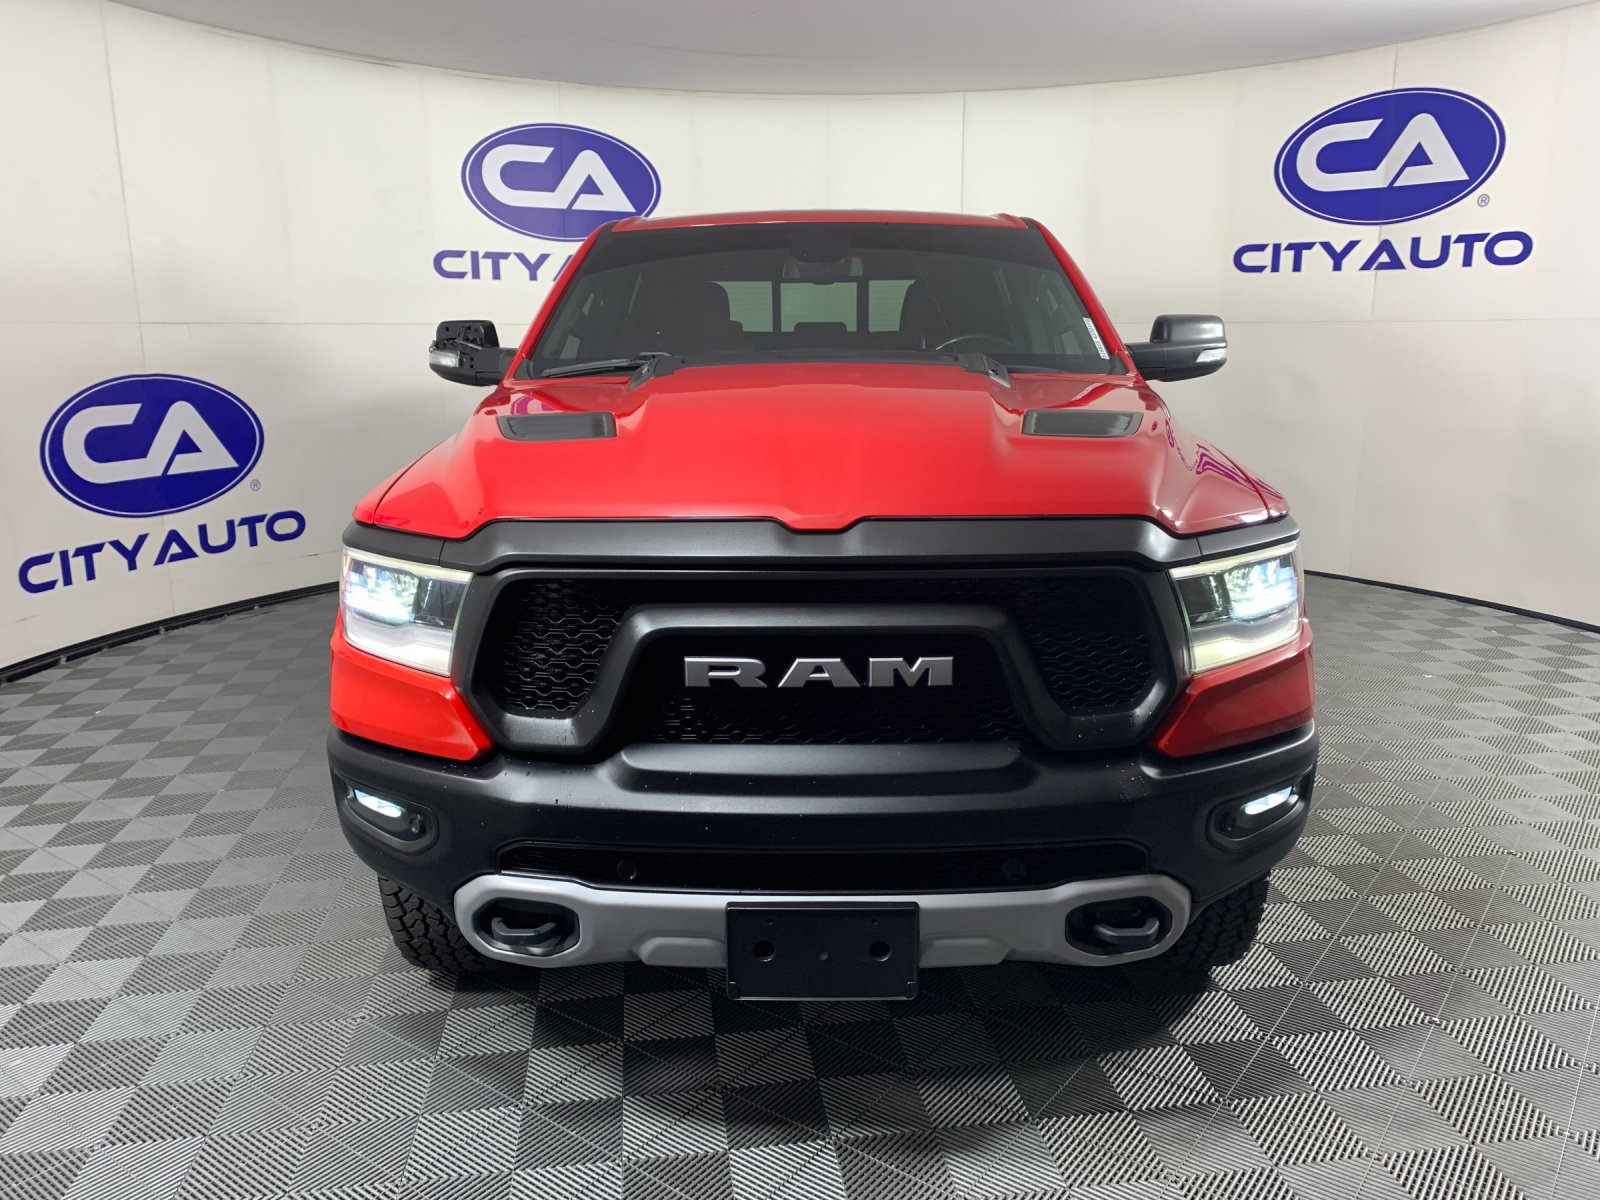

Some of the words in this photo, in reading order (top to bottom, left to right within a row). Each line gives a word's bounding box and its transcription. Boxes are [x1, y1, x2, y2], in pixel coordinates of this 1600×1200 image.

[481, 143, 637, 213] CA
[1296, 112, 1470, 193] CA
[432, 249, 552, 282] CITY
[62, 399, 240, 484] CA
[684, 655, 954, 688] RAM
